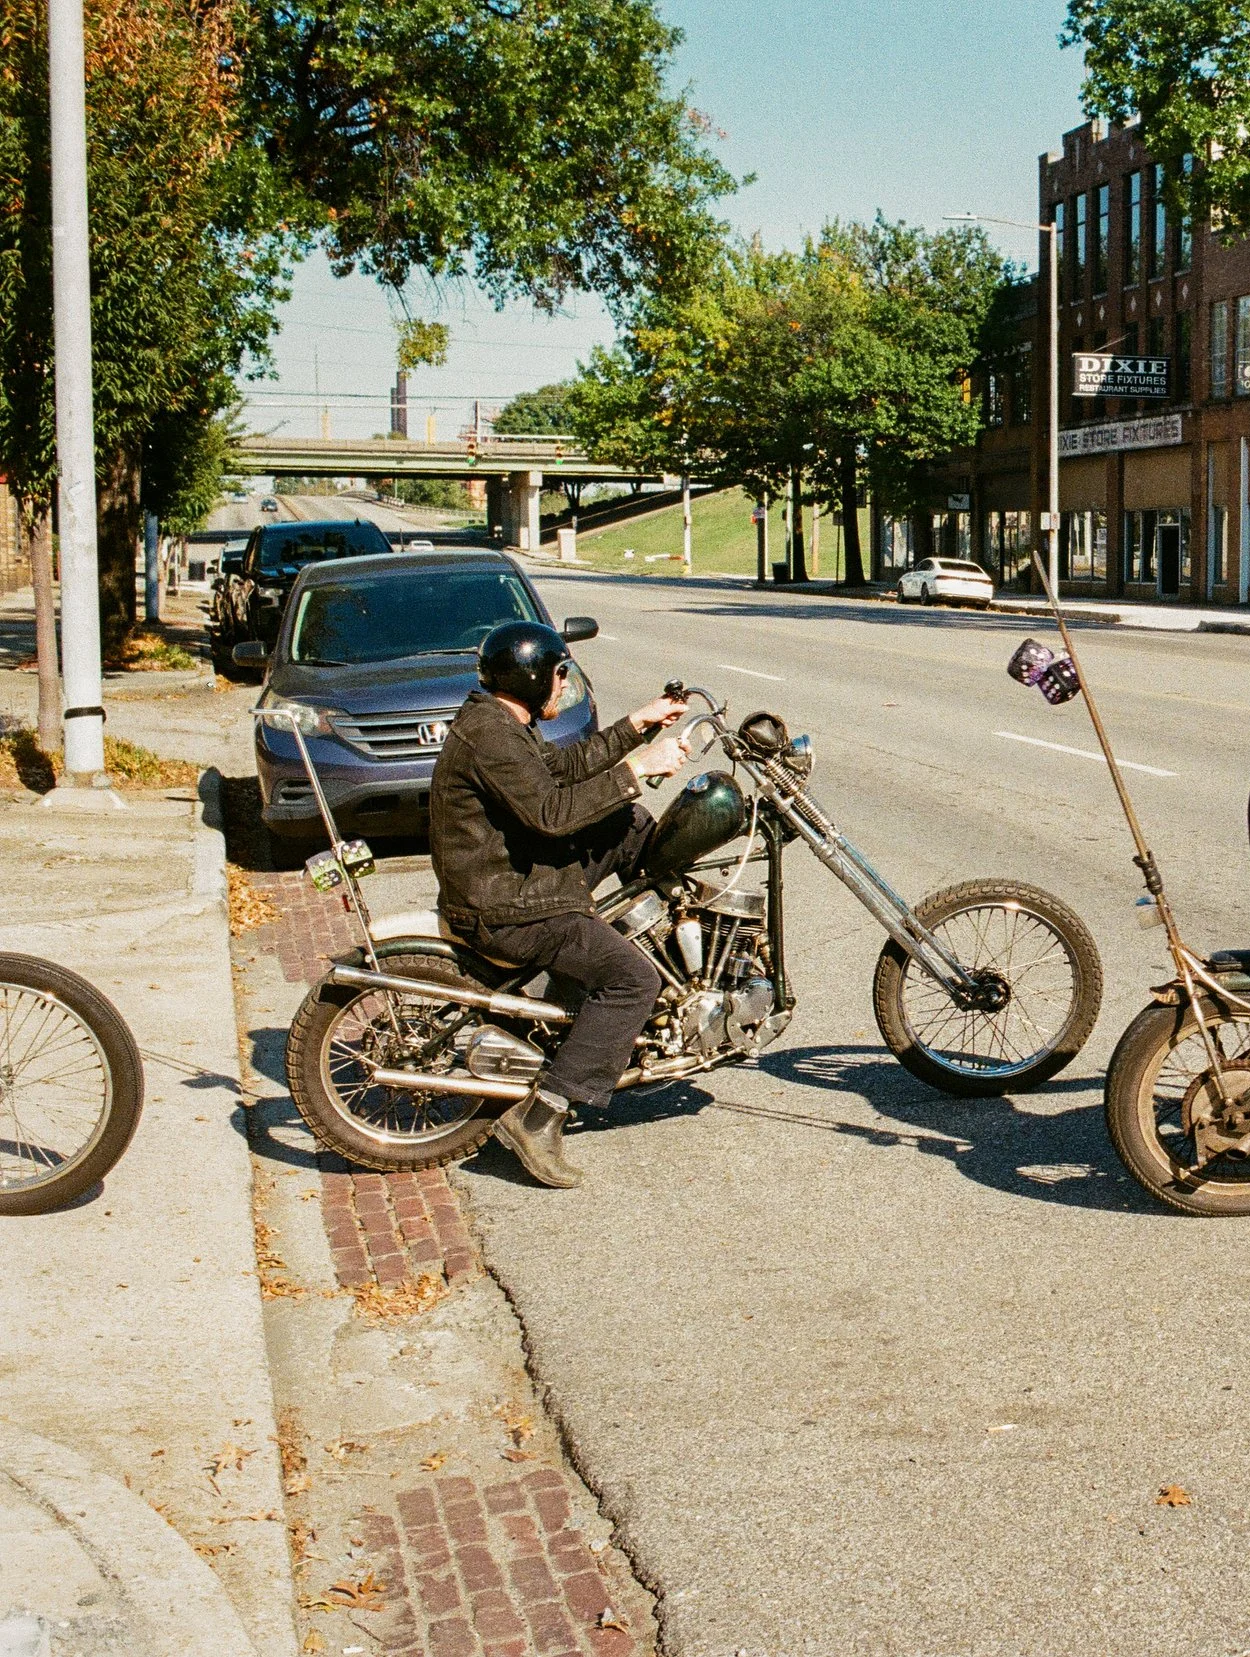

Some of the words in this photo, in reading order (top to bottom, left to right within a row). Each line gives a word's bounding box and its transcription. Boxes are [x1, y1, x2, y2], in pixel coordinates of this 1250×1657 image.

[1080, 357, 1166, 374] DIXIE
[1080, 374, 1114, 383] STORE
[1116, 375, 1166, 385] FIXTURES
[1079, 384, 1128, 393] RESTAURANT
[1129, 386, 1166, 395] SUPPLIES
[1058, 434, 1078, 450] IXIE
[1082, 428, 1118, 449] STORE
[1122, 419, 1180, 442] FIXTURES
